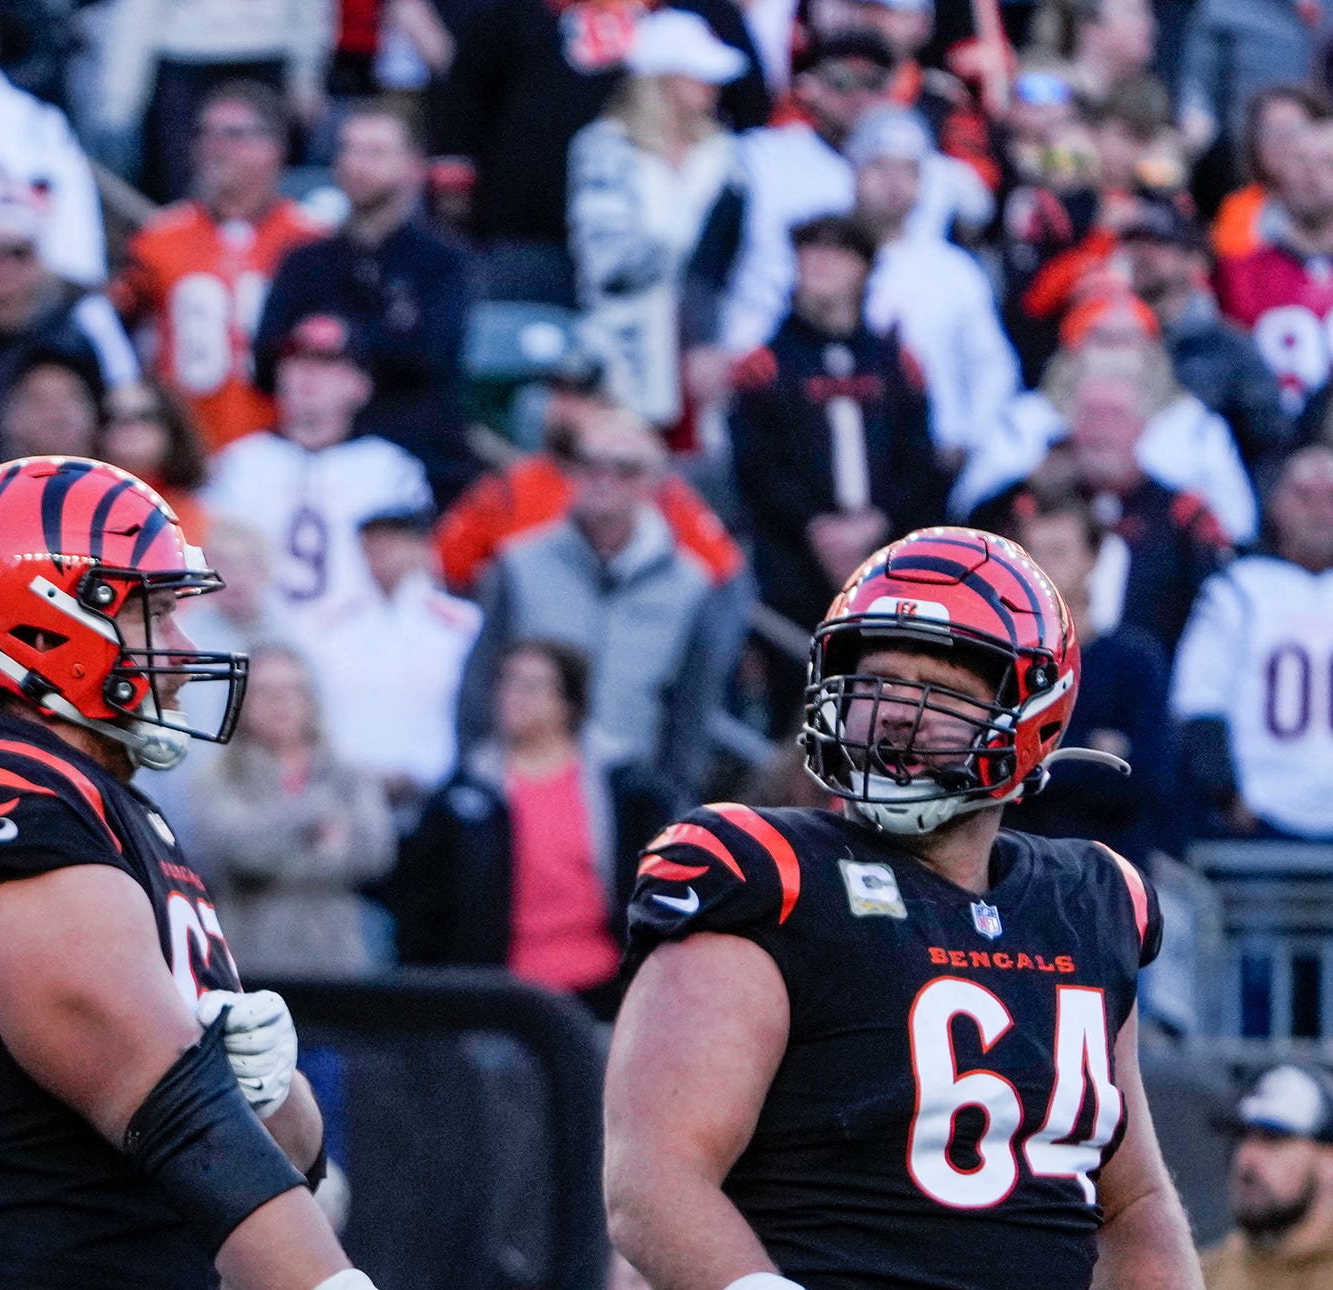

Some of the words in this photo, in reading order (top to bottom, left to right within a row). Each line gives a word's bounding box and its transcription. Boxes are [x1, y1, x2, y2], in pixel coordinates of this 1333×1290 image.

[277, 503, 328, 604] 9
[1265, 642, 1333, 743] 0
[928, 947, 1076, 974] BENGALS
[906, 975, 1124, 1210] 64
